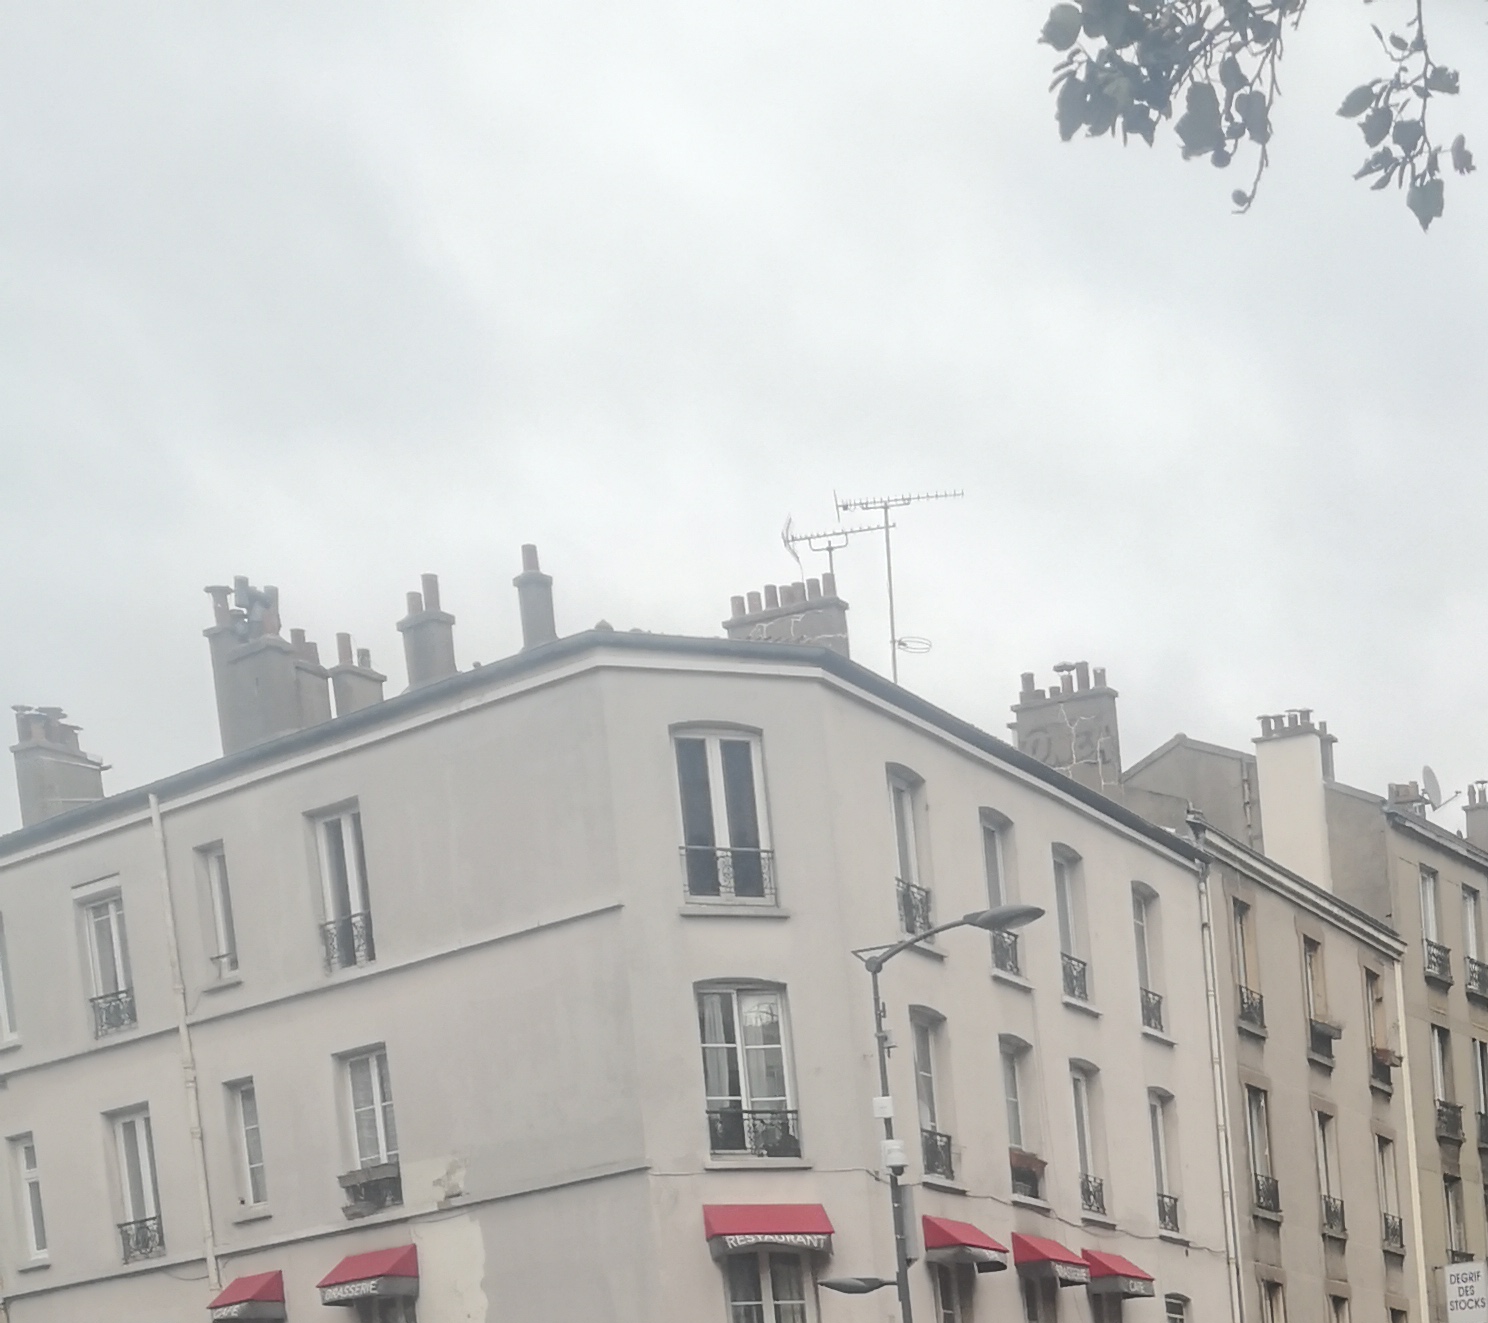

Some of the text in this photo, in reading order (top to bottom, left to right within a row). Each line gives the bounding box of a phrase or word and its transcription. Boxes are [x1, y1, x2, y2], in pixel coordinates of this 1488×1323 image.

[1450, 1271, 1481, 1285] DEGRIF
[1458, 1285, 1475, 1297] DES
[1450, 1298, 1486, 1311] STOCKS
